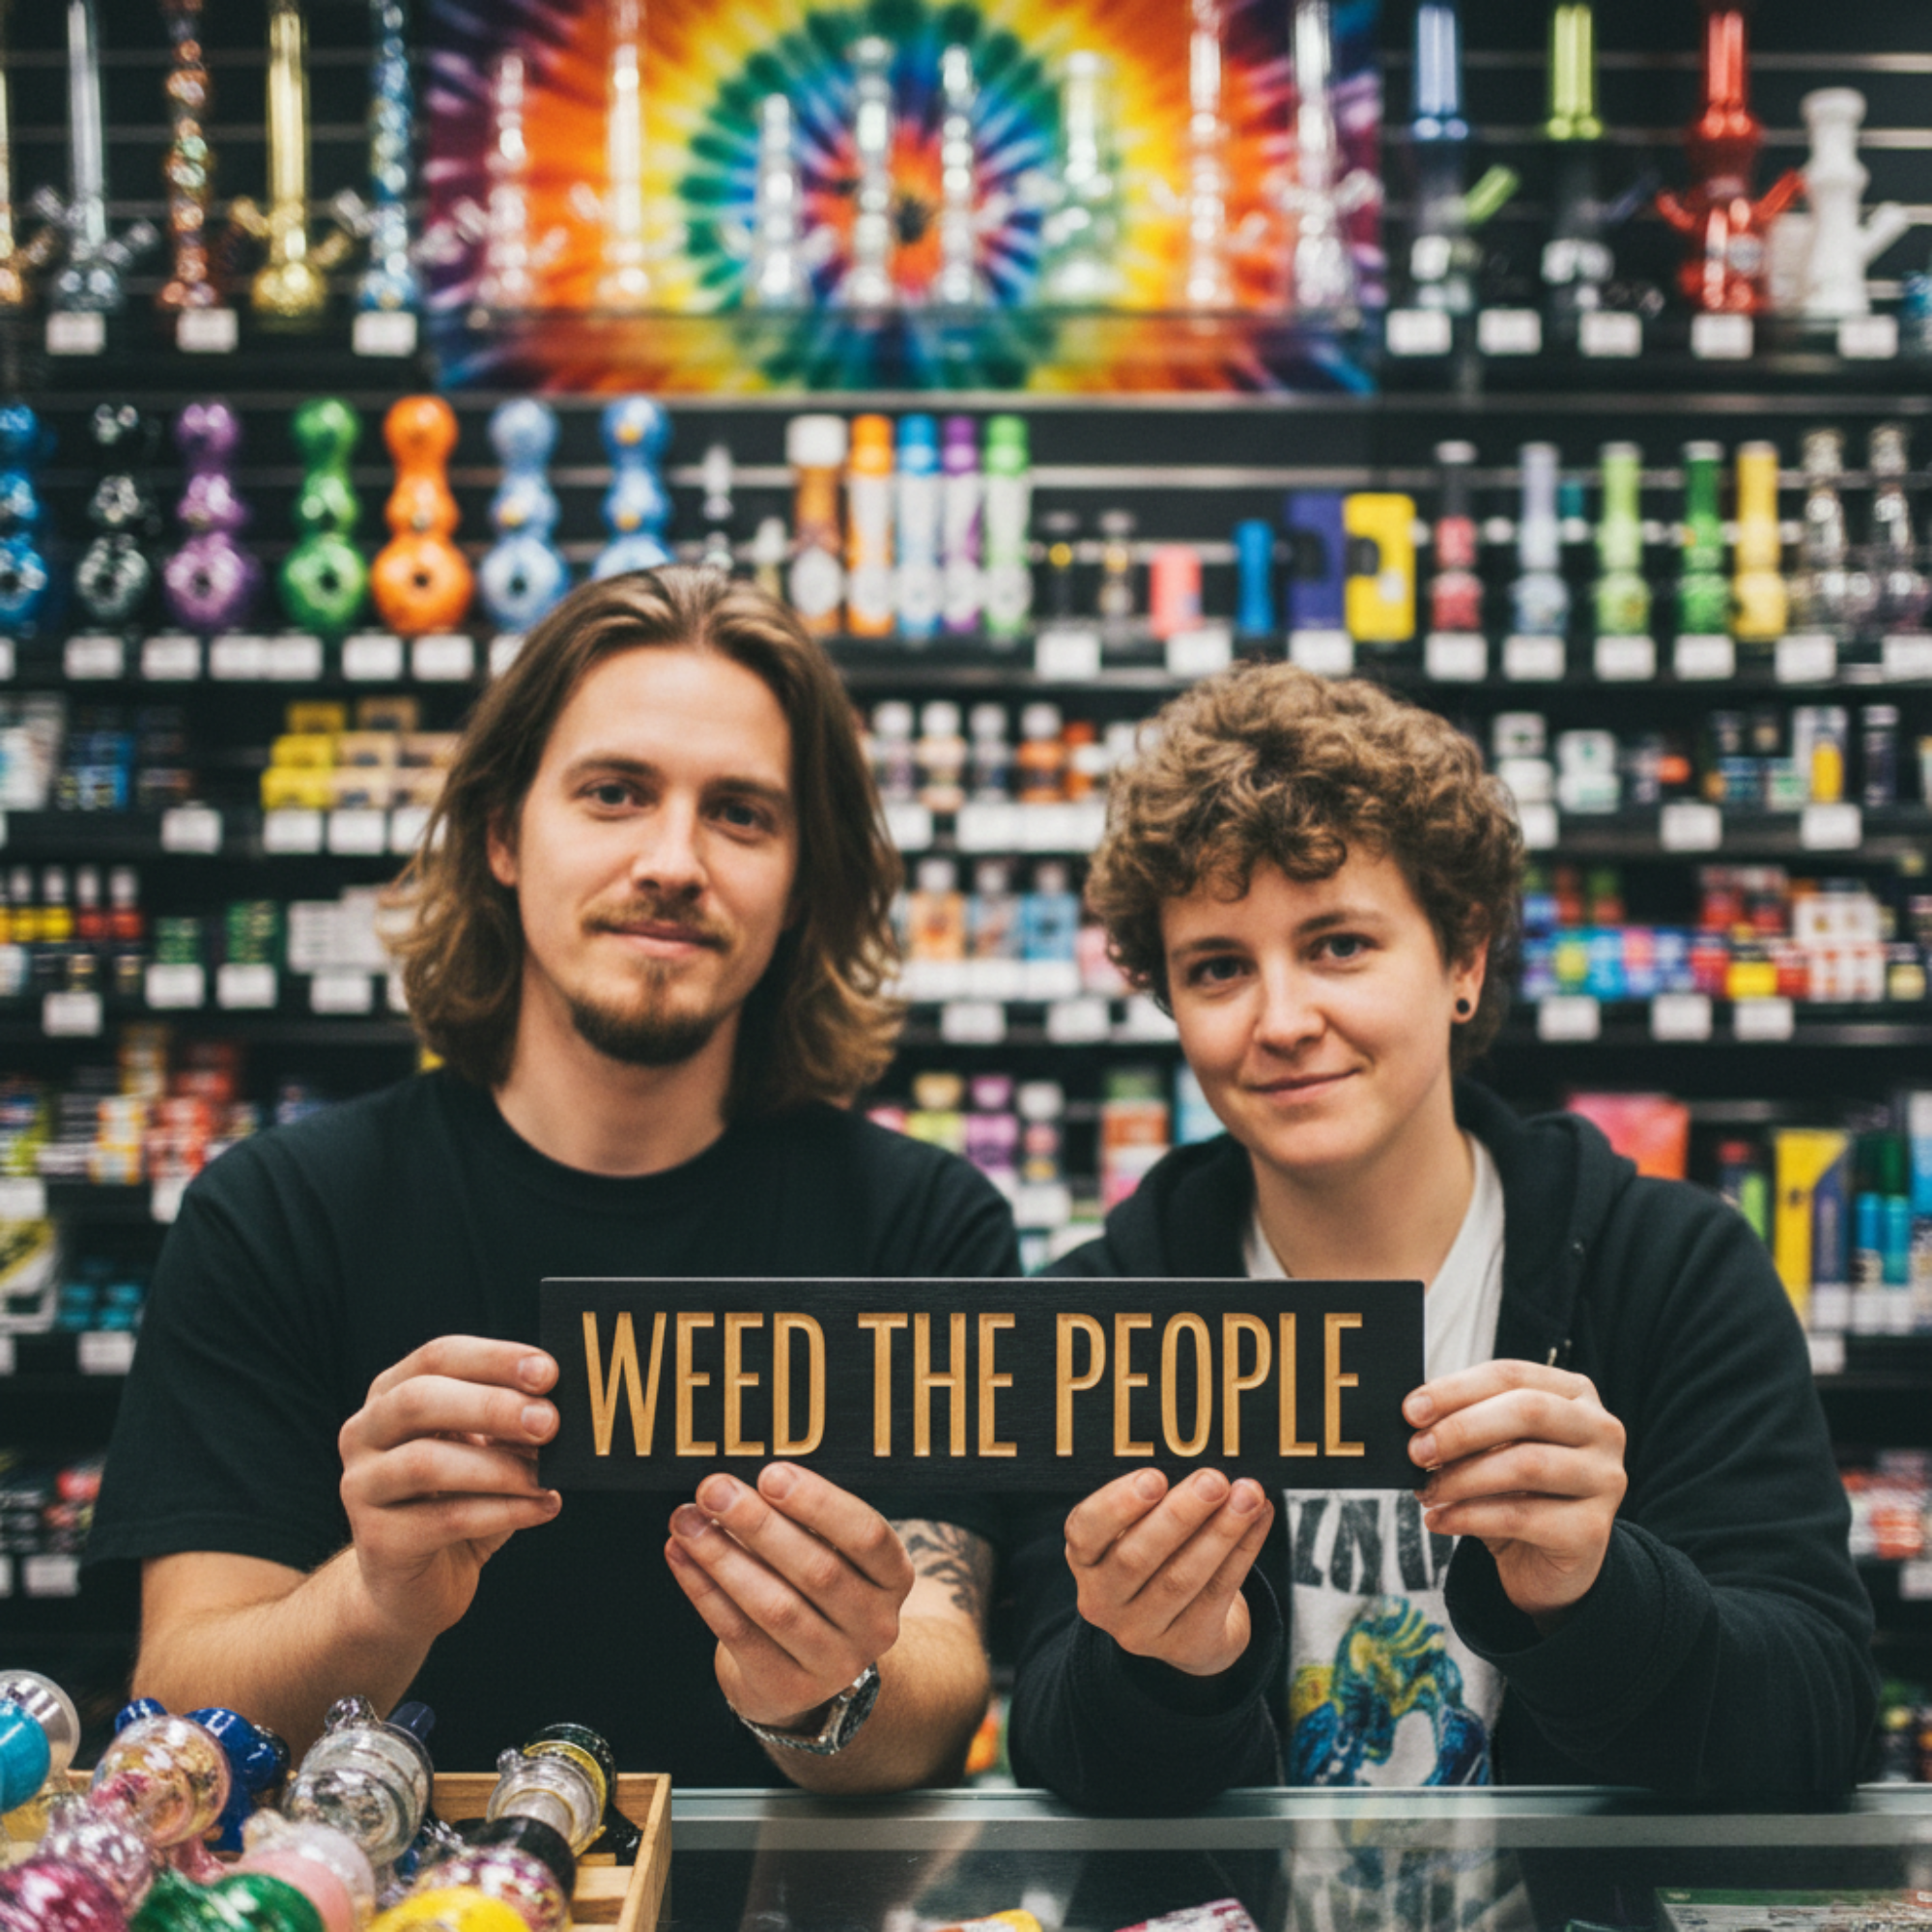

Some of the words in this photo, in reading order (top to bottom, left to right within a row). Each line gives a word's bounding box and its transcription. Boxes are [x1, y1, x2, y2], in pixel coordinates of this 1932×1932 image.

[582, 1312, 827, 1458] WEED
[857, 1312, 1018, 1458] THE
[1056, 1312, 1366, 1459] PEOPLE
